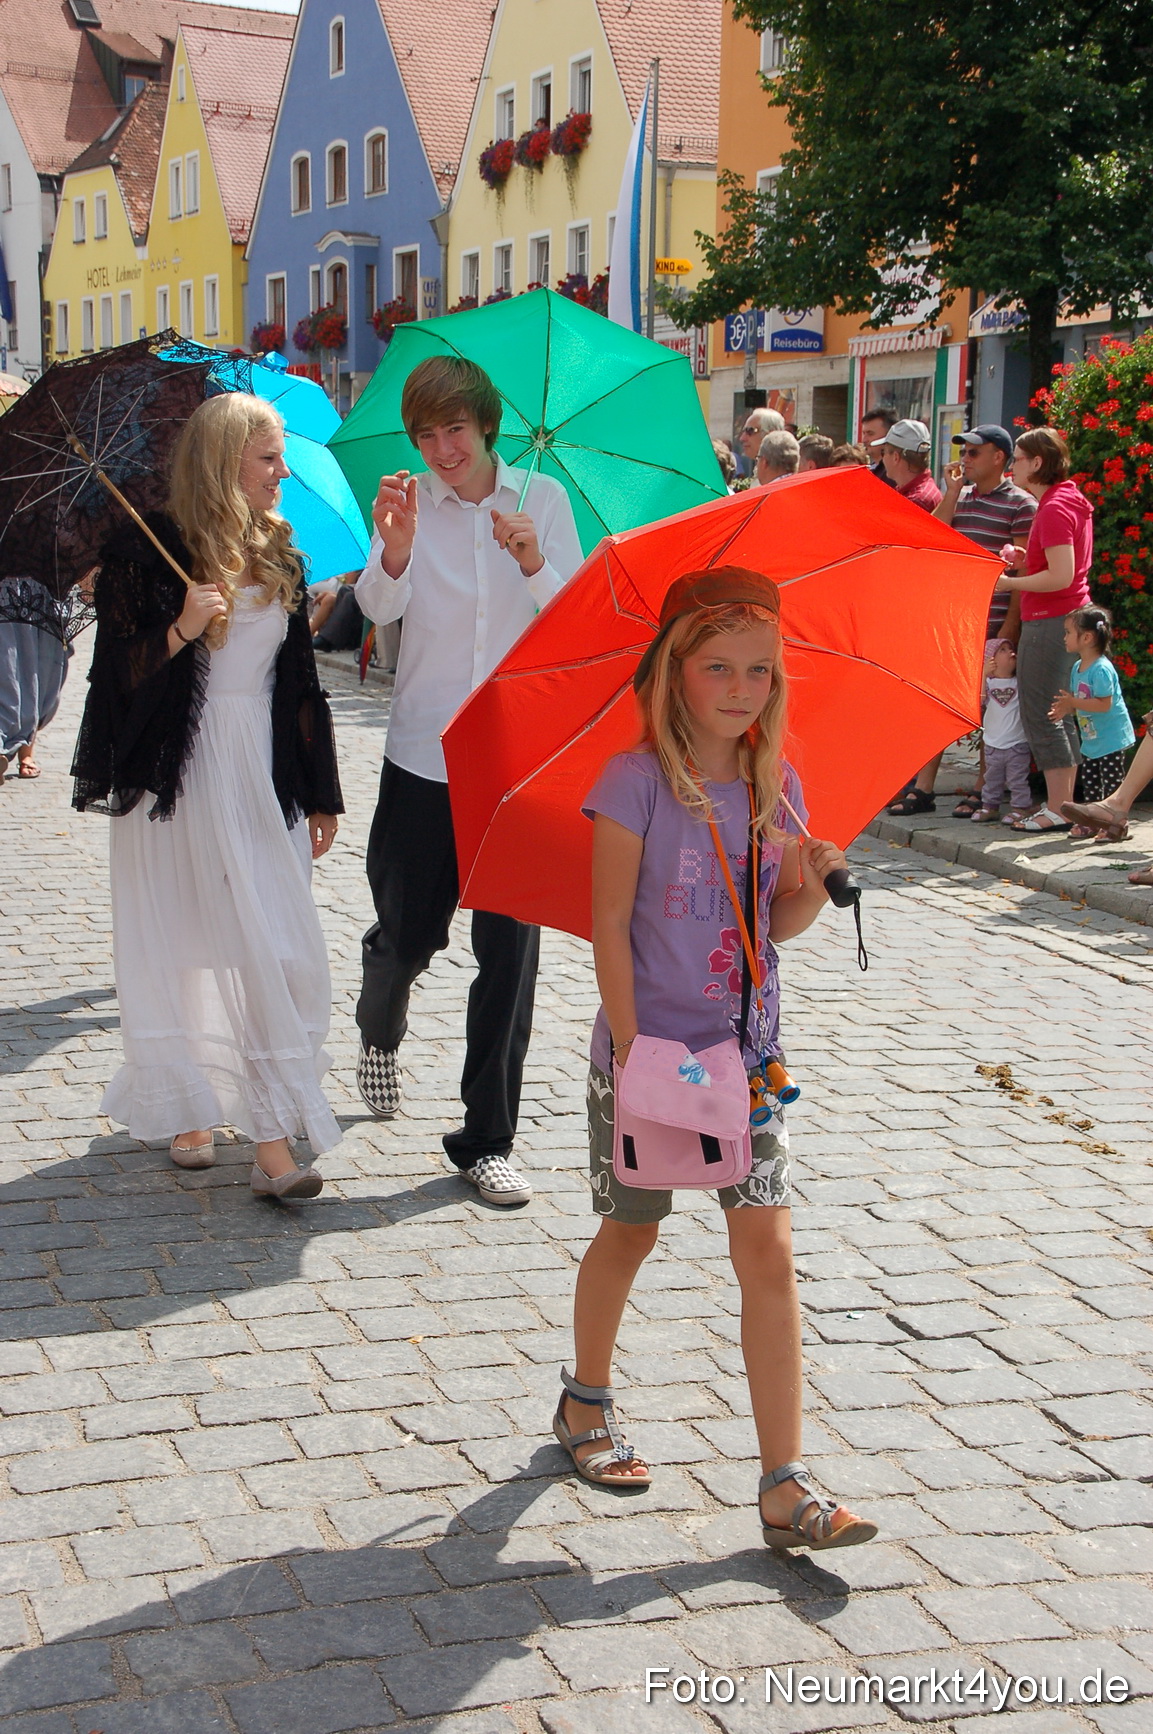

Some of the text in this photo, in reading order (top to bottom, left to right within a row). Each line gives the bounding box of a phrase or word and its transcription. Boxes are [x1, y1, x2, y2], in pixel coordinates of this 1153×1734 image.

[655, 261, 675, 272] KINO
[87, 267, 110, 288] HOTEL
[698, 321, 706, 375] INO
[773, 338, 820, 350] Reisebüro
